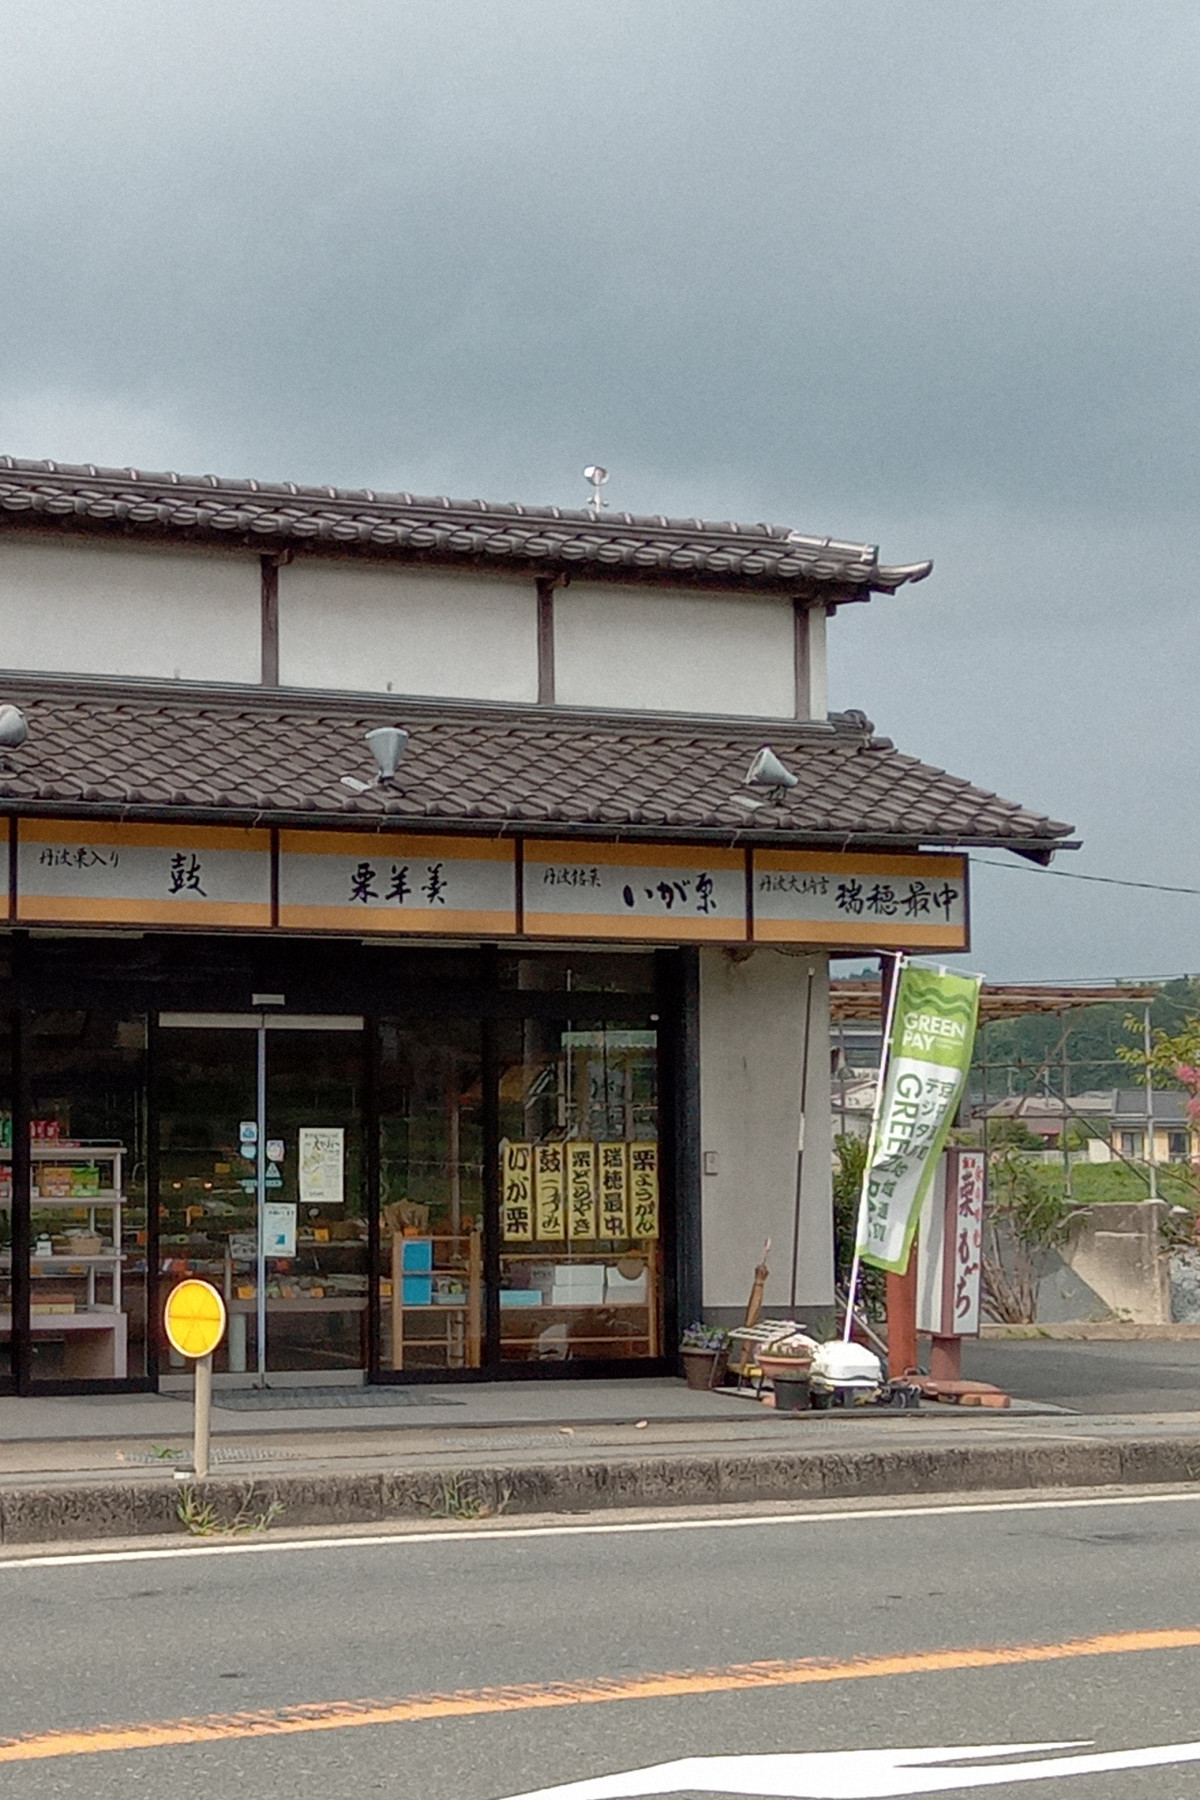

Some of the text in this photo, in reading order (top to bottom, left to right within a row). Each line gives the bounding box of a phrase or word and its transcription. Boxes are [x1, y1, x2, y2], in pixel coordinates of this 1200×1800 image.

[168, 852, 208, 898] 鼓
[901, 1029, 937, 1051] PAY
[903, 1012, 966, 1040] GREEN
[506, 1147, 530, 1234] いが栗
[602, 1147, 625, 1236] 瑞穂最中
